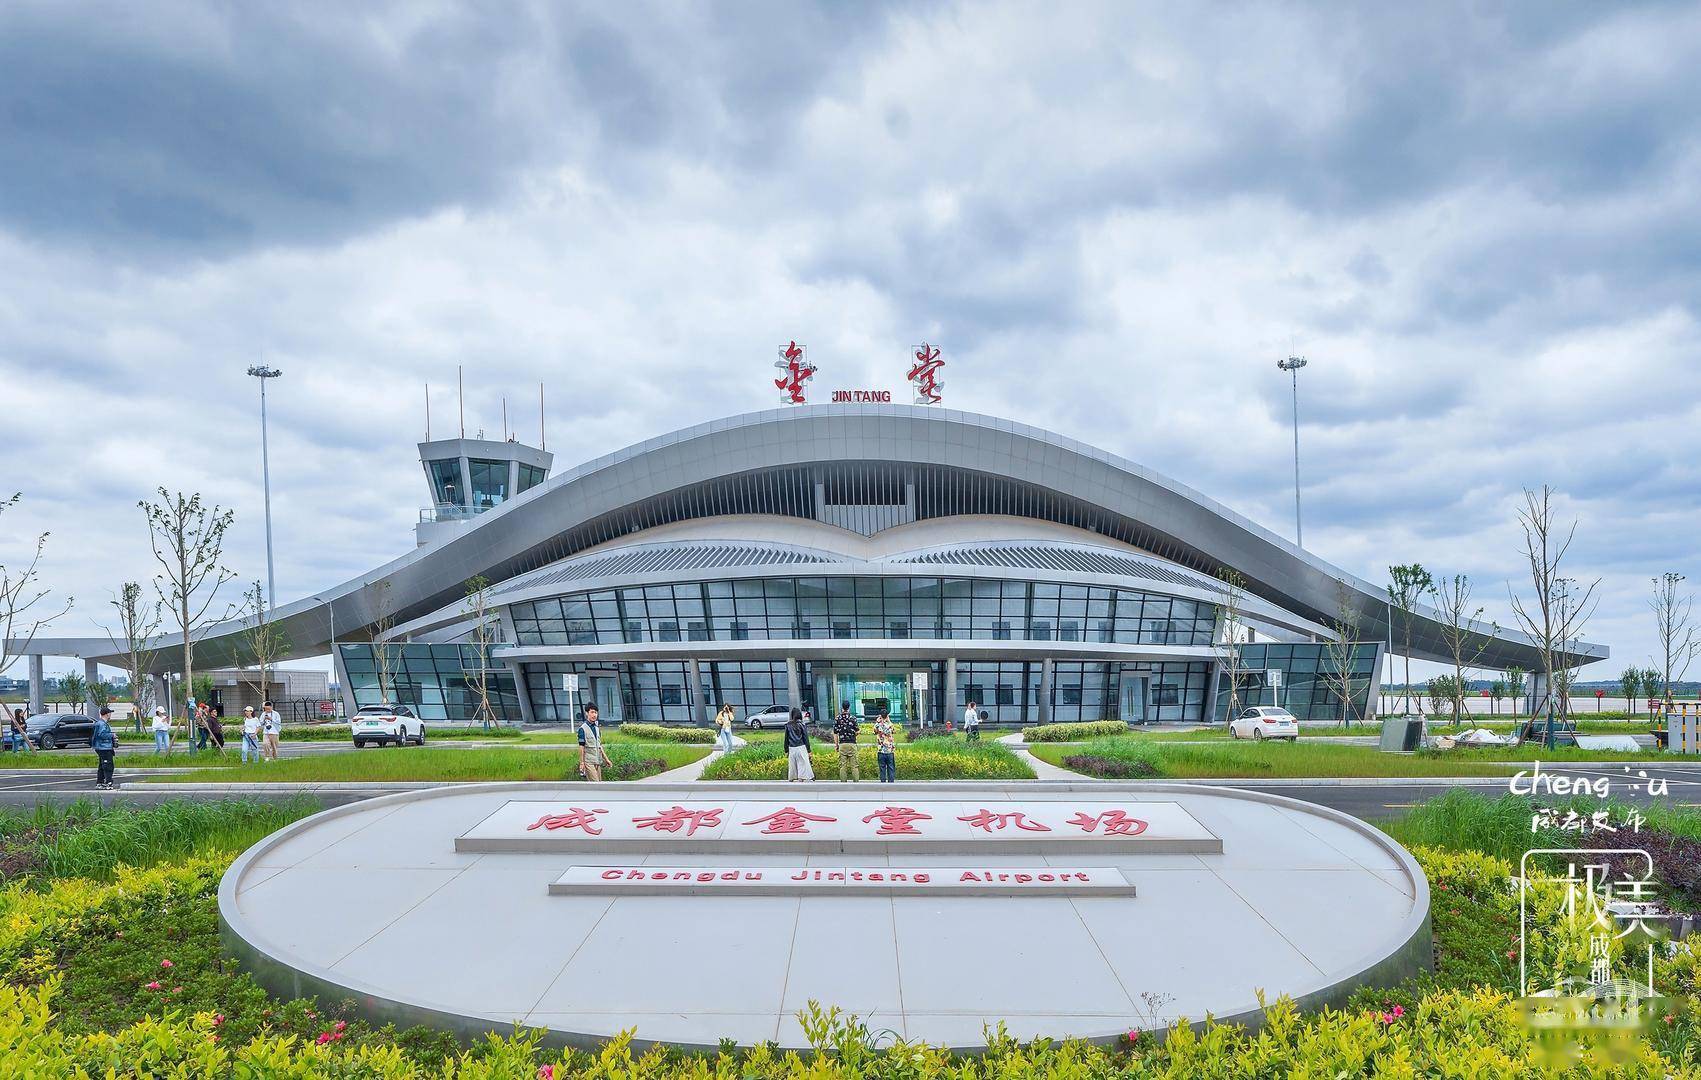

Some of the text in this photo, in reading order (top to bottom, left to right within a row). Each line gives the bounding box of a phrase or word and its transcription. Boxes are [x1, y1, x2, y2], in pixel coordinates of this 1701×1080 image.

[775, 341, 813, 403] 金
[907, 343, 945, 404] 堂
[832, 391, 890, 402] JIN TANG
[527, 806, 1149, 836] 成都金堂机场
[601, 870, 1090, 883] Chengdu Jintang Airport
